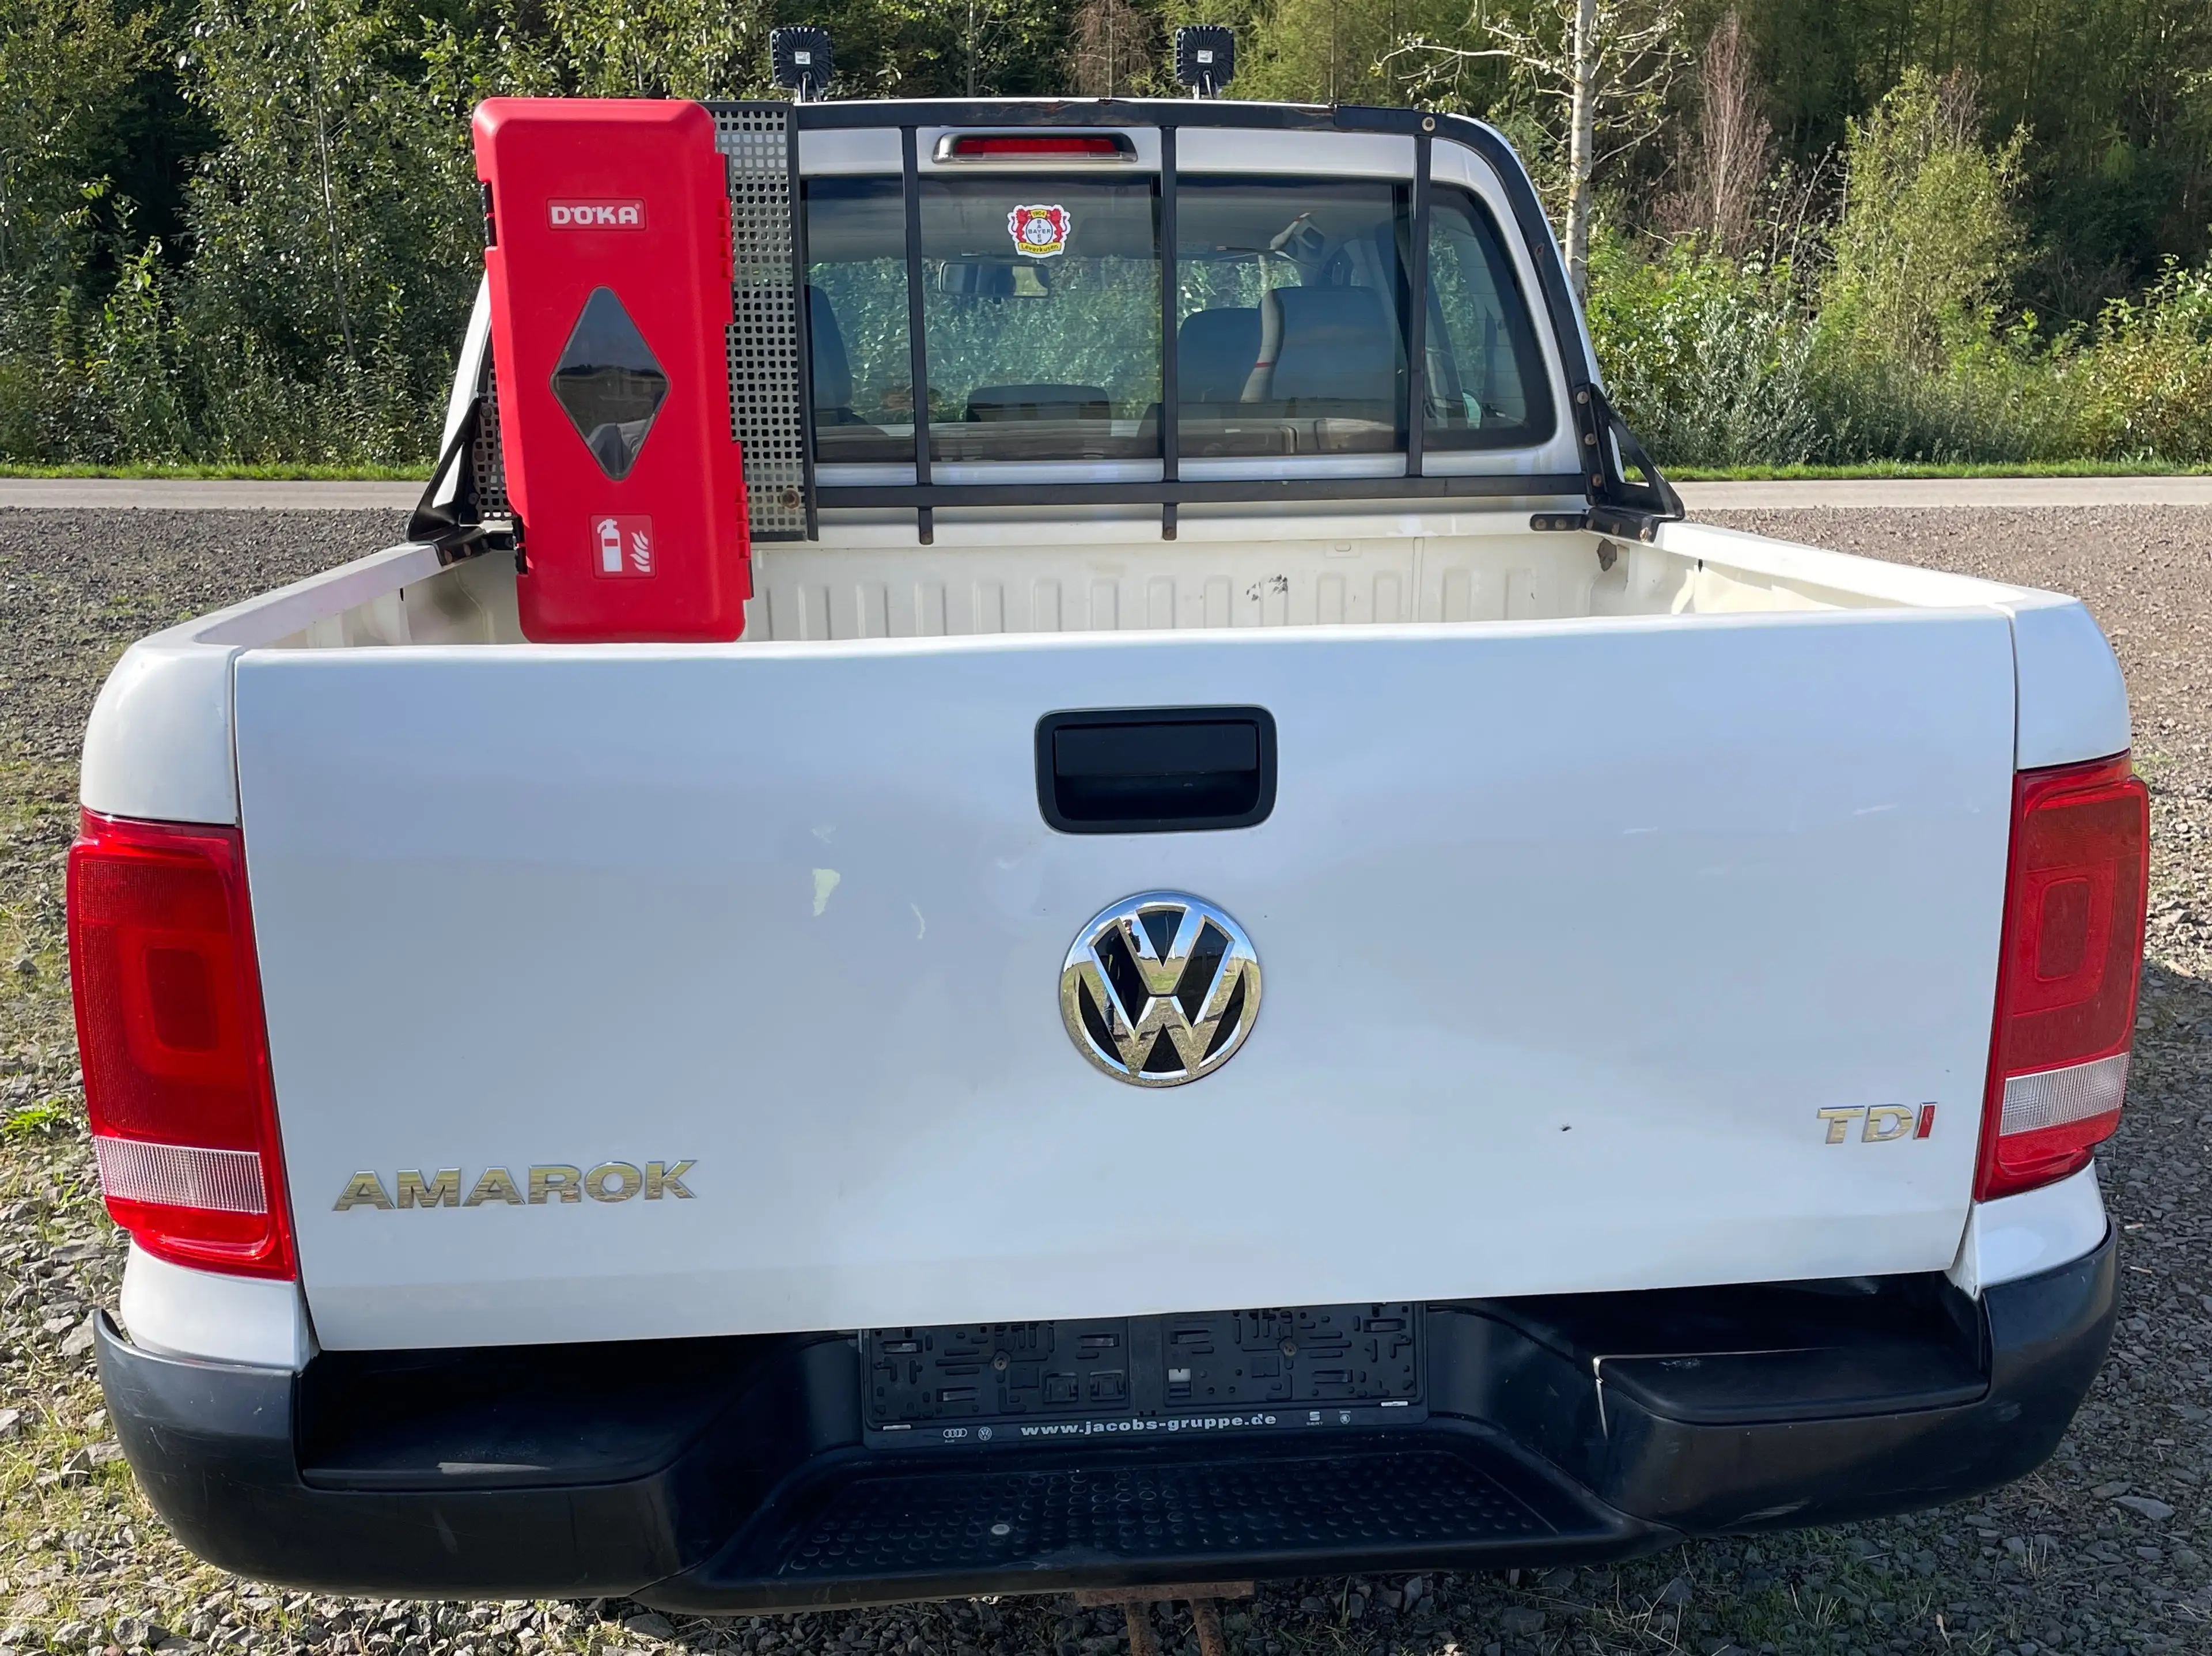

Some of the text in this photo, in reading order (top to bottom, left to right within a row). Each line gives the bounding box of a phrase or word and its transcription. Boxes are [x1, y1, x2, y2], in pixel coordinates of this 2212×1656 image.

[1816, 1102, 1938, 1144] TDI
[332, 1159, 698, 1211] AMAROK
[1021, 1413, 1277, 1436] www.jacobs-gruppe.de
